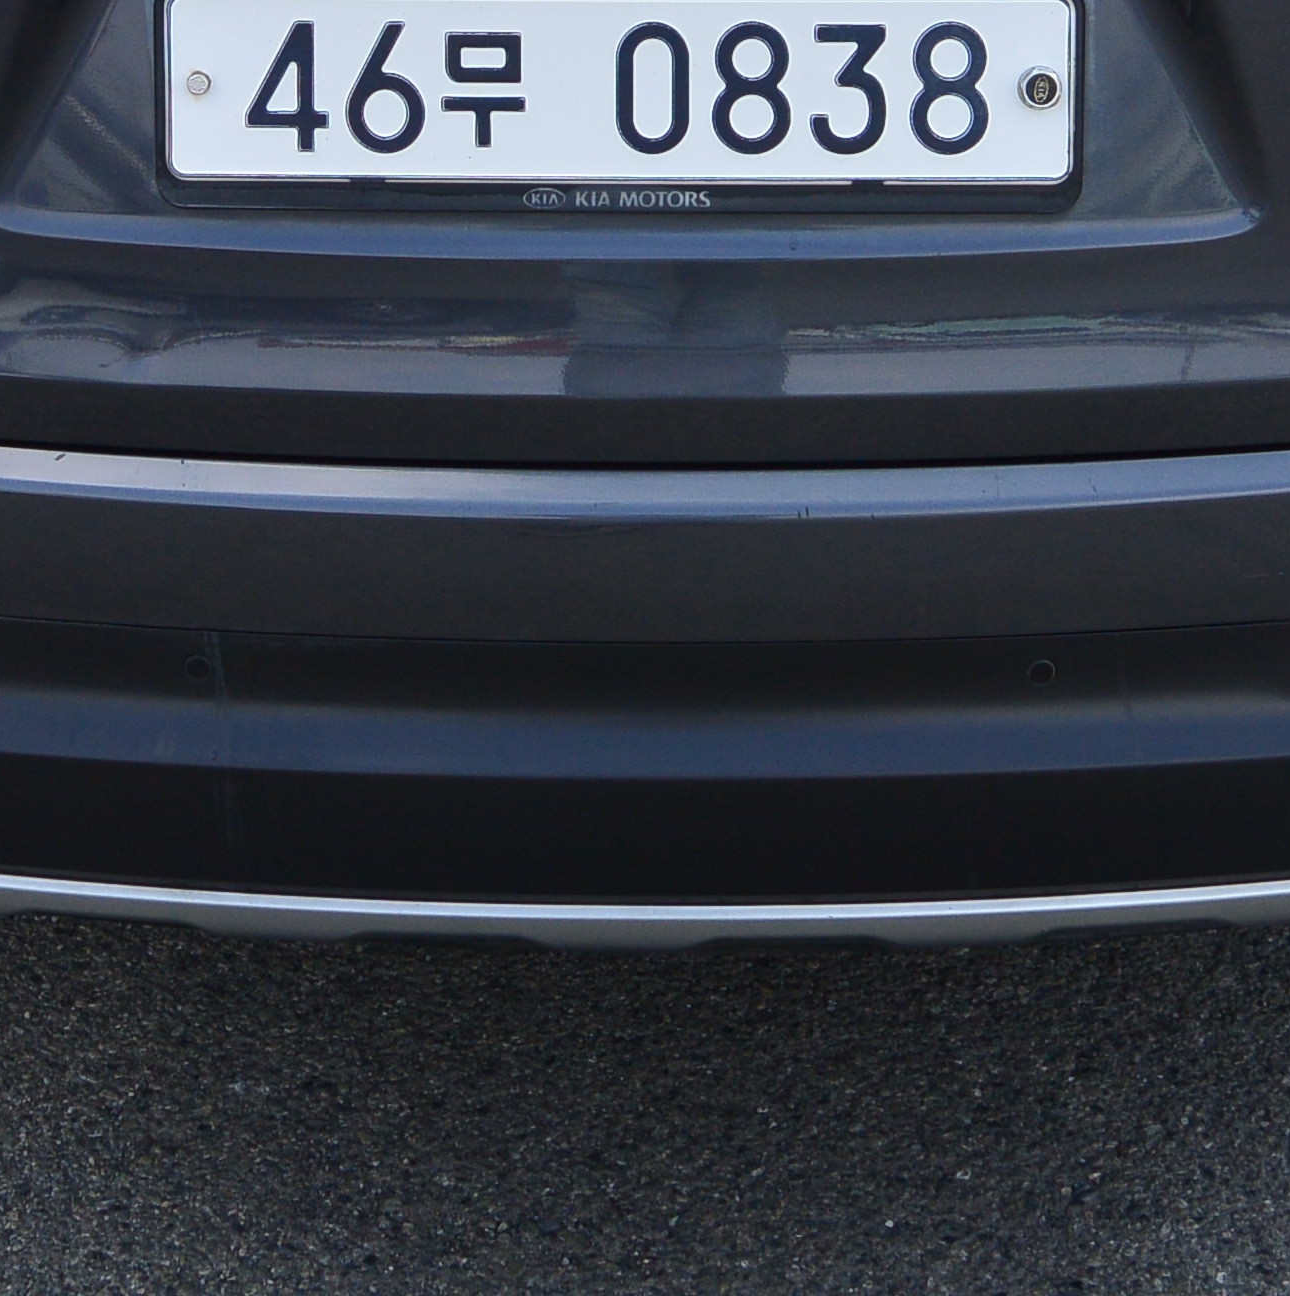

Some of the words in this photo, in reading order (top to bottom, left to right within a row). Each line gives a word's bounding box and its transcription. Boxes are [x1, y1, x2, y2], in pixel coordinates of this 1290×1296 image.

[244, 20, 527, 155] 46무
[615, 20, 990, 156] 0838
[575, 190, 610, 207] KIA
[619, 190, 711, 208] MOTORS
